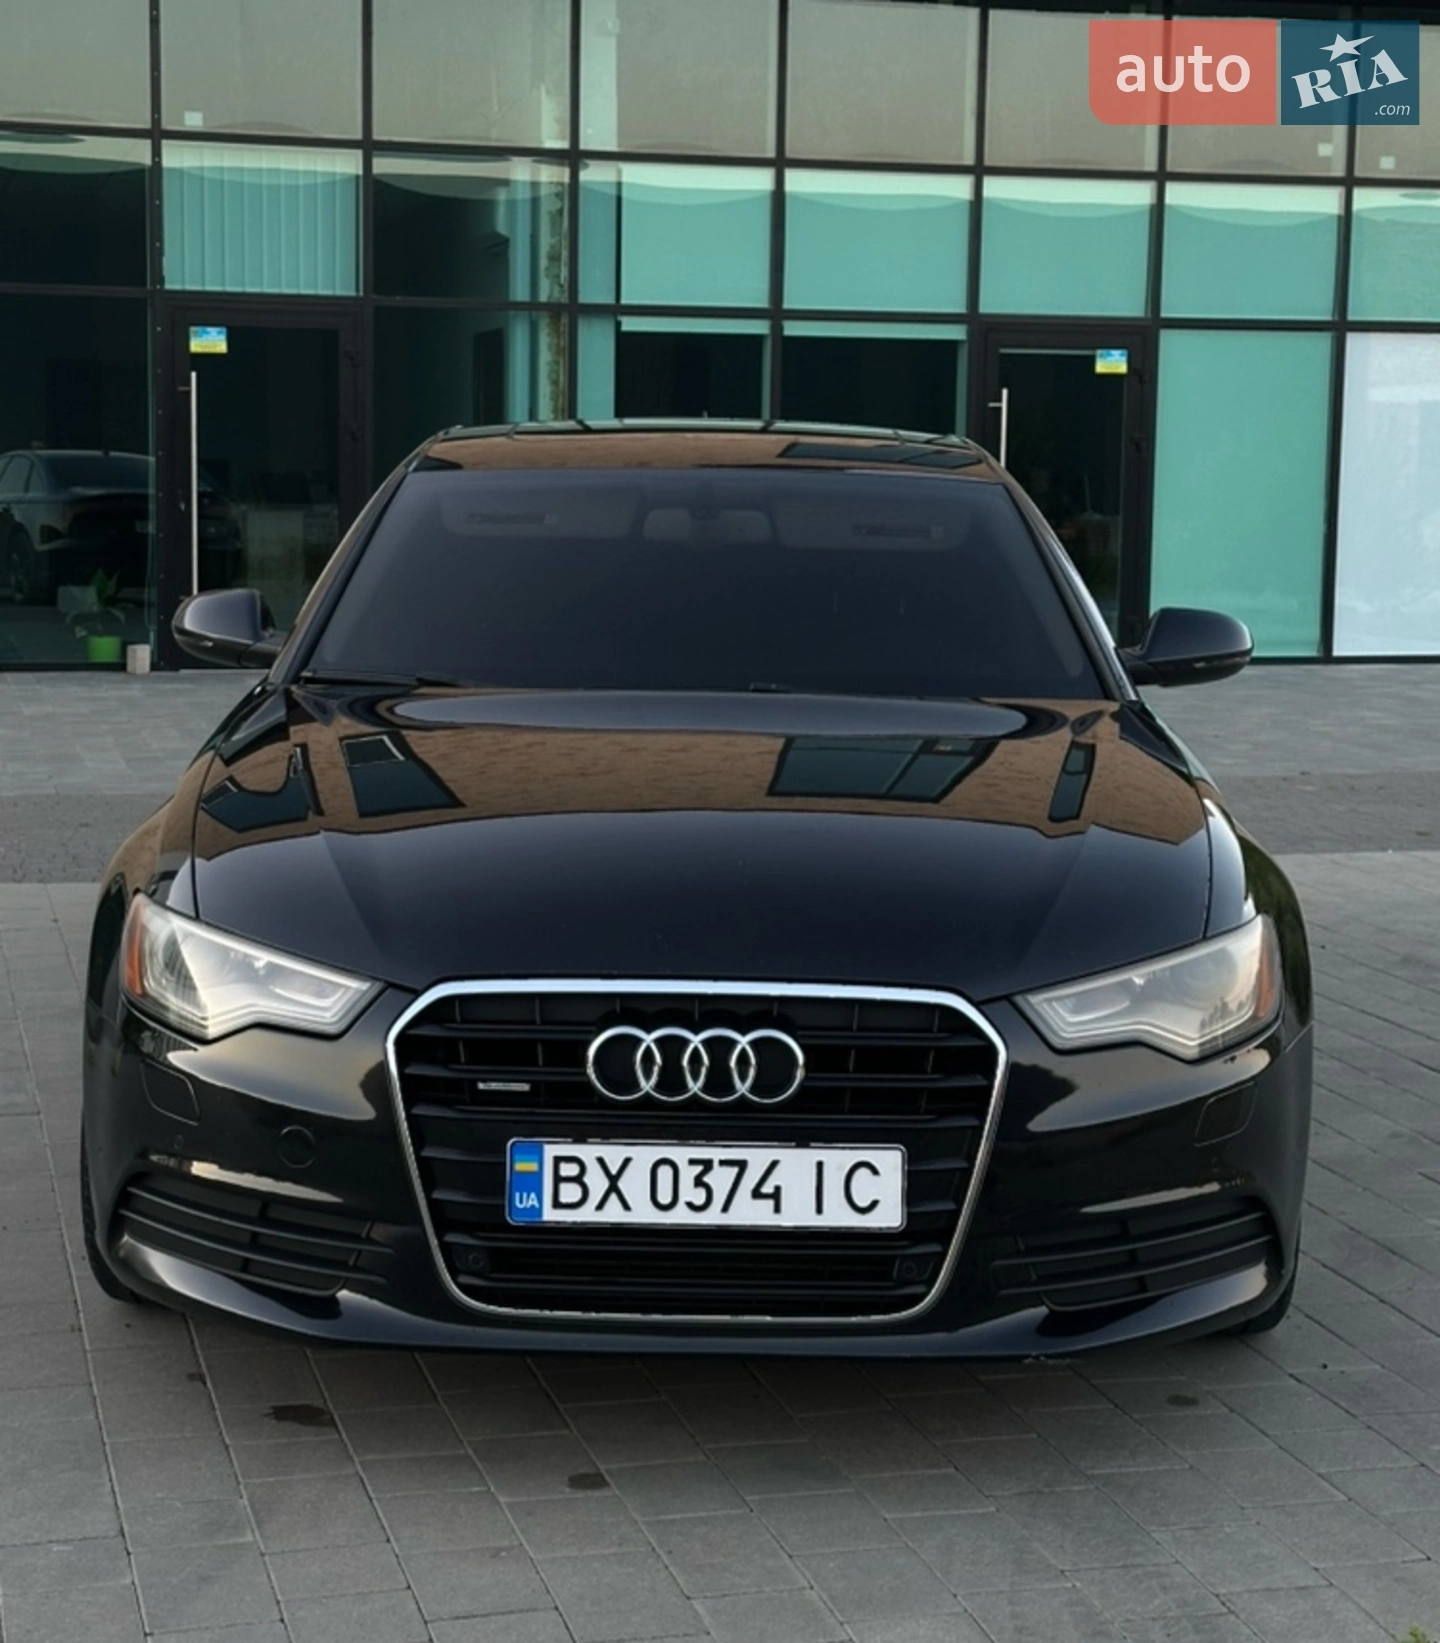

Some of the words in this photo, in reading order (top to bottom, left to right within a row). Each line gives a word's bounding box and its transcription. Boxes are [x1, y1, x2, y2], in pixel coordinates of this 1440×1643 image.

[515, 1192, 539, 1209] UA
[551, 1155, 633, 1212] BX
[649, 1157, 782, 1215] 0374
[815, 1160, 881, 1216] IC
